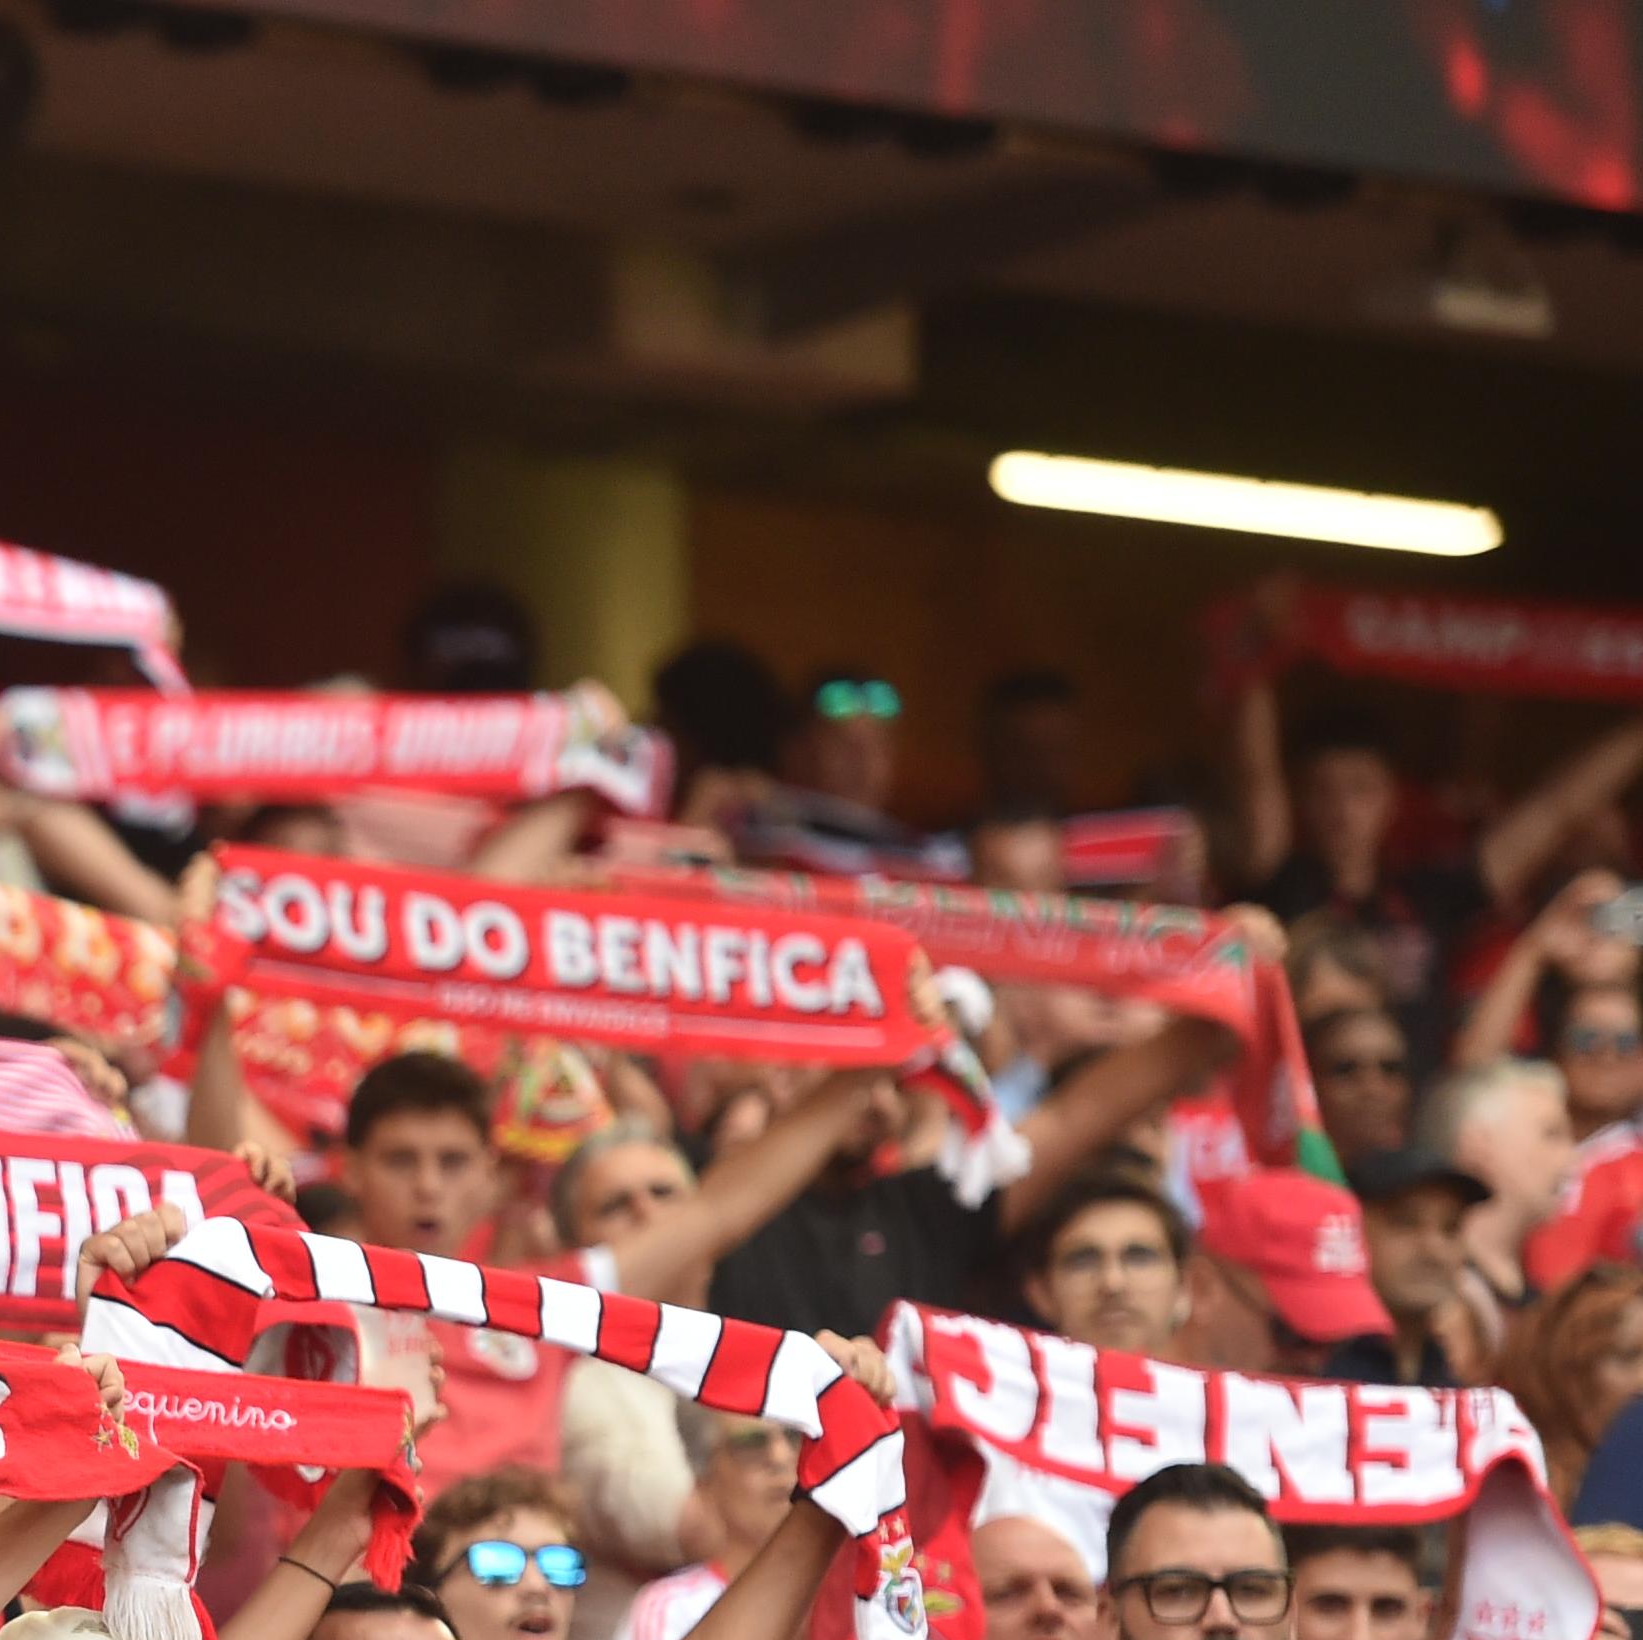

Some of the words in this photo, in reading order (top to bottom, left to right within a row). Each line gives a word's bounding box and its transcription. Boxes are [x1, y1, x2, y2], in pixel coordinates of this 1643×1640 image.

[220, 867, 387, 960] SOU
[401, 892, 528, 978] DO
[546, 908, 887, 1019] BENFICA
